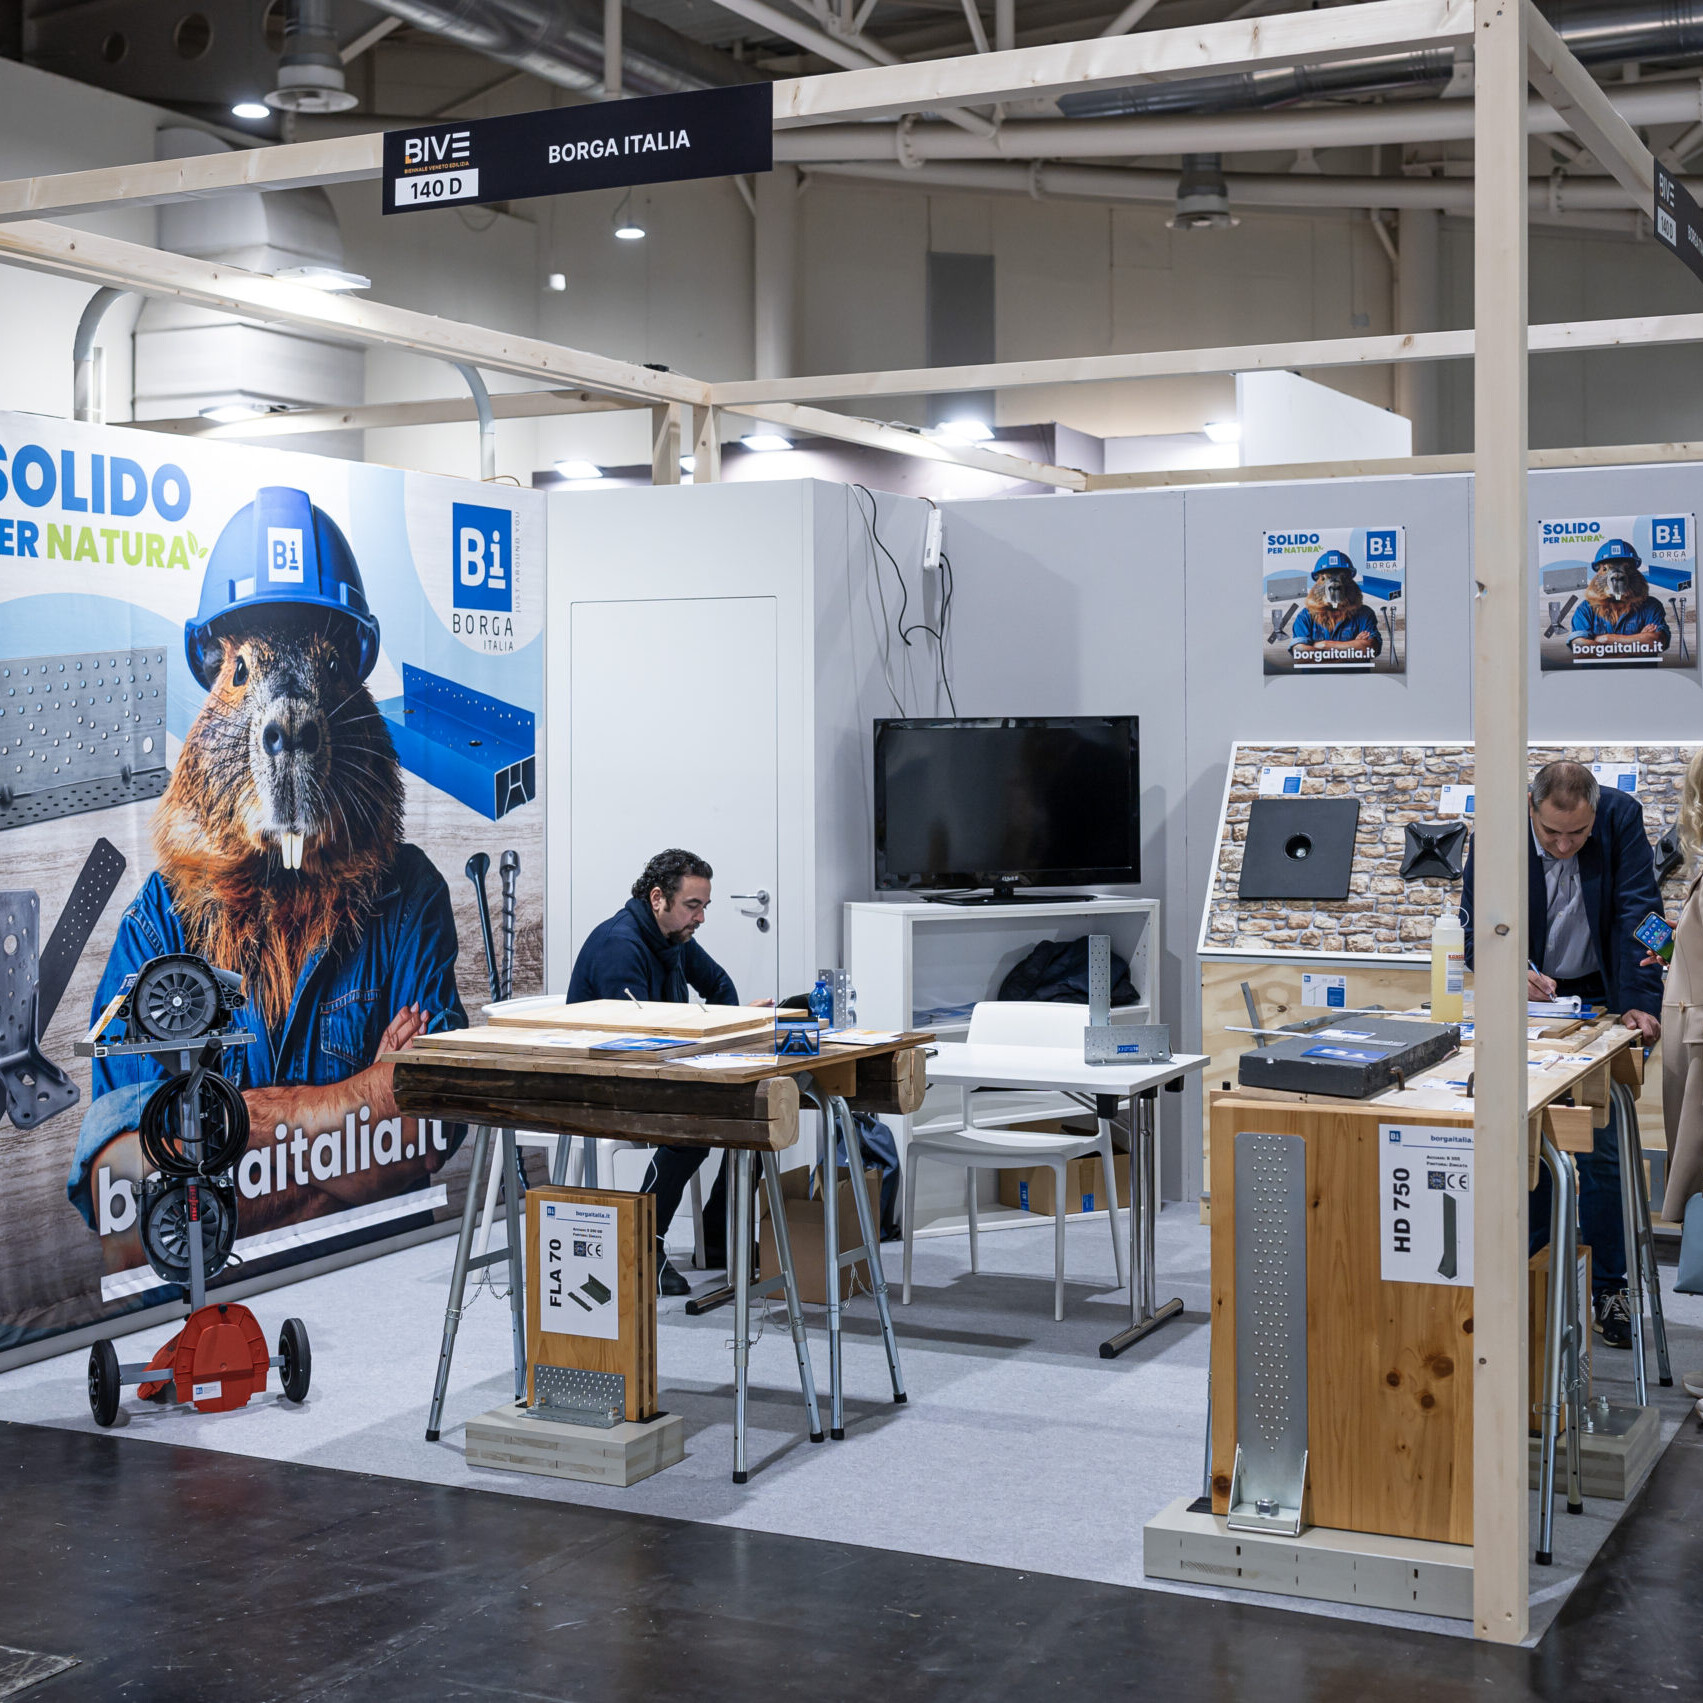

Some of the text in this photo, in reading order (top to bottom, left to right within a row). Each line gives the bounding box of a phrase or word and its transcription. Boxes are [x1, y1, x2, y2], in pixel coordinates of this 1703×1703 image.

[404, 131, 470, 164] BIVE
[548, 129, 690, 165] BORGA ITALIA
[429, 163, 449, 171] VENETO
[411, 177, 462, 200] 140 D
[1659, 172, 1675, 208] BIVE
[0, 443, 191, 522] OLIDO
[1543, 521, 1600, 535] SOLIDO
[1656, 524, 1682, 544] Bi
[0, 518, 191, 571] ER NATURA
[1267, 533, 1320, 546] SOLIDO
[1284, 545, 1319, 554] NATURA
[1369, 537, 1394, 555] Bi
[1543, 534, 1600, 544] PER NATURA
[460, 527, 506, 589] Bi
[453, 613, 514, 637] BORGA
[483, 639, 514, 652] ITALIA
[1293, 647, 1376, 662] borgaitalia.it
[1572, 641, 1664, 657] borgaitalia.it
[1430, 1135, 1474, 1143] borgaitalia.
[98, 1105, 447, 1236] baitalia.it
[1393, 1167, 1411, 1253] HD 750
[550, 1239, 562, 1307] FLA 70
